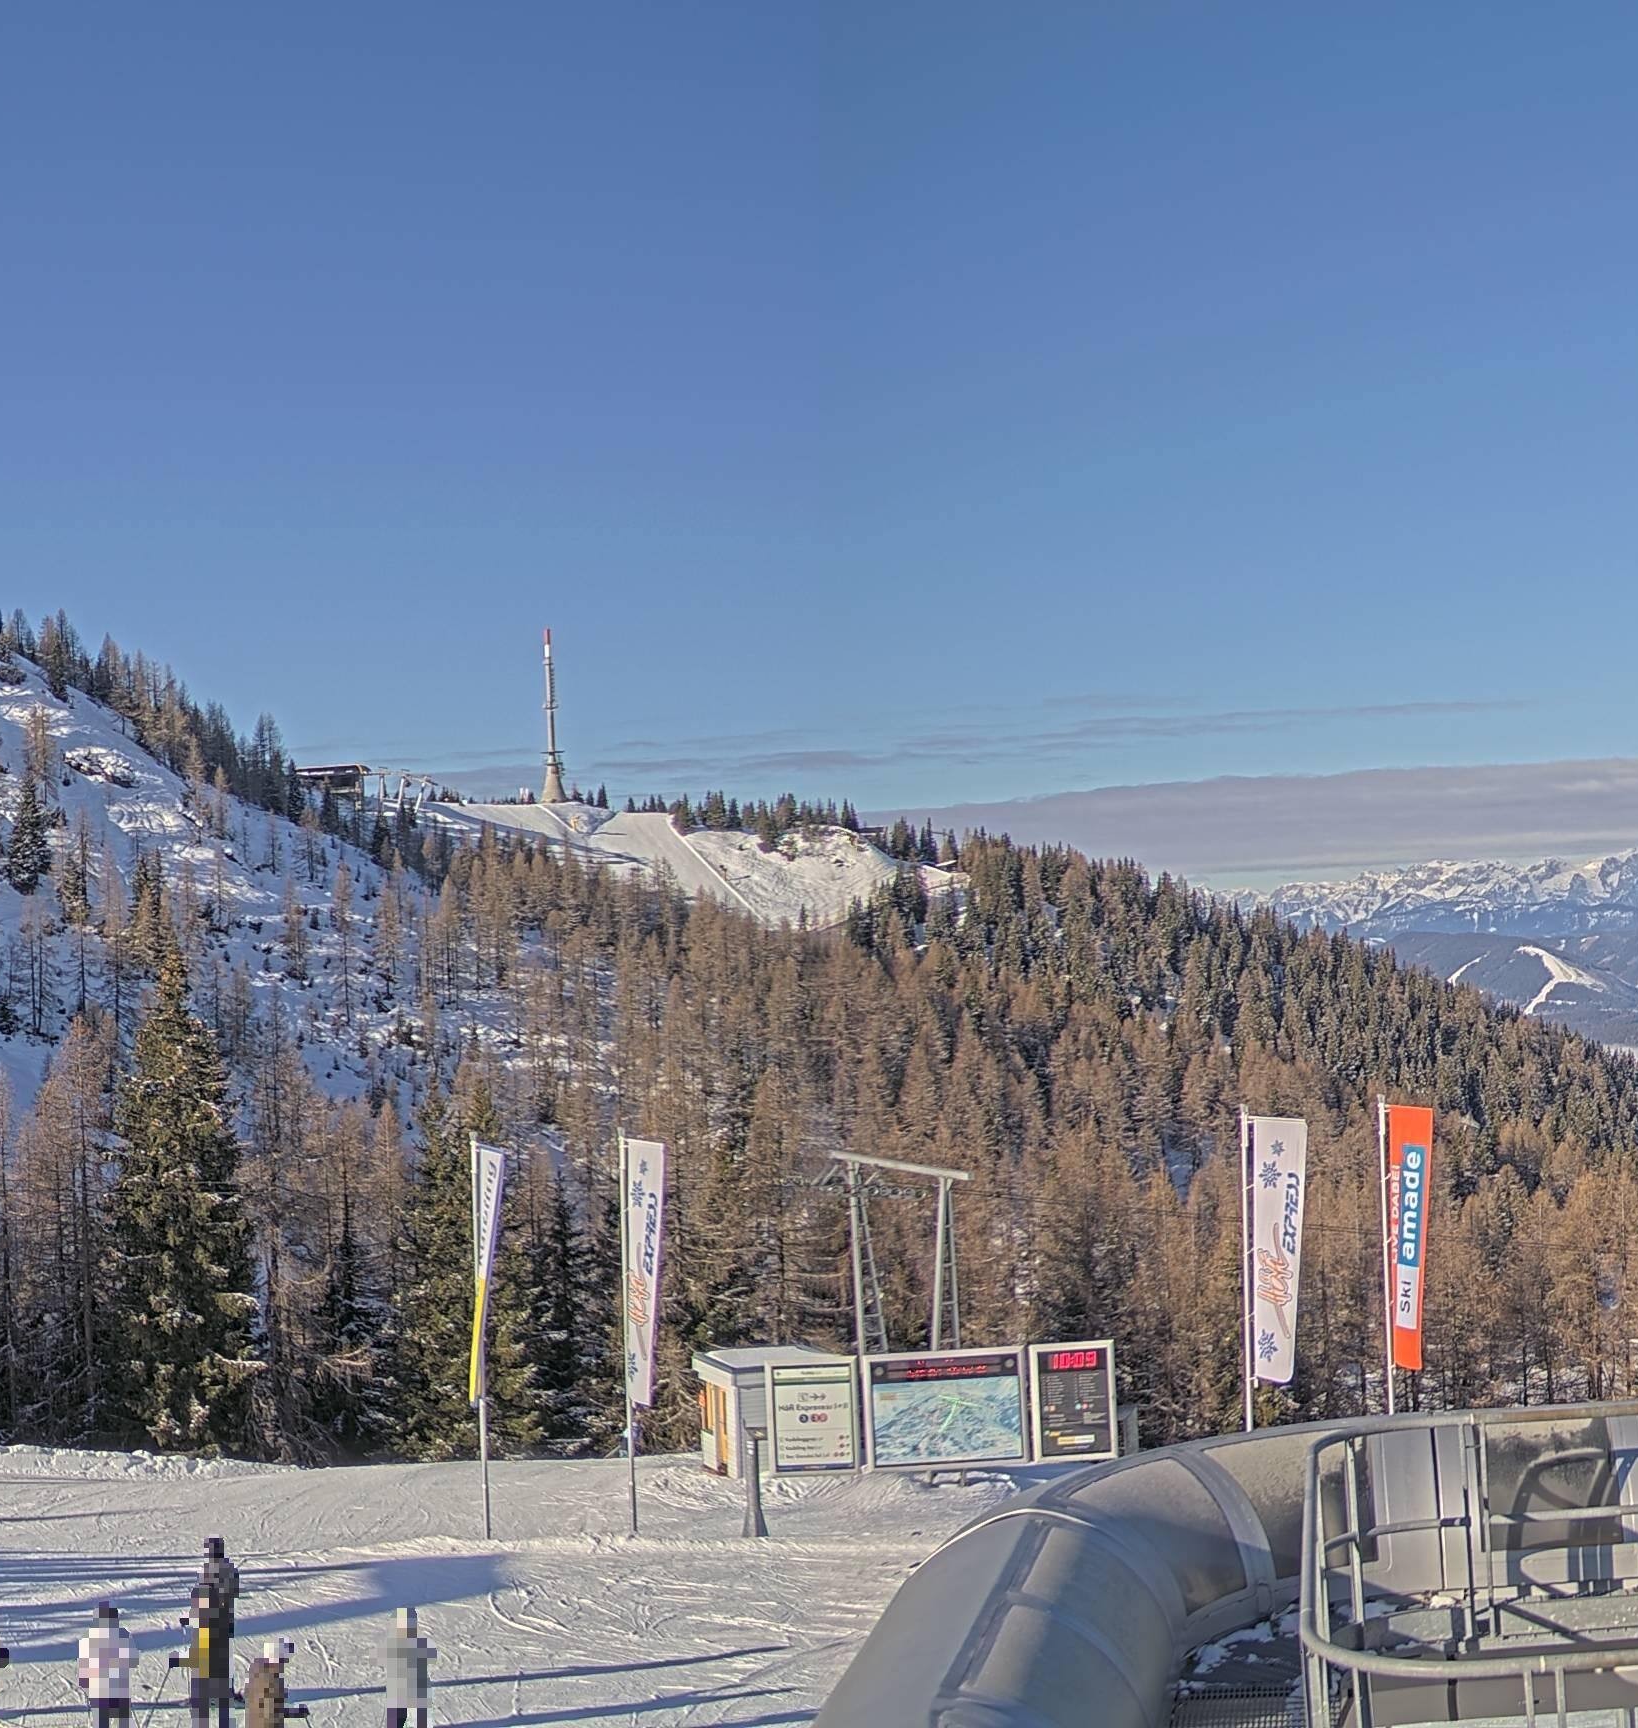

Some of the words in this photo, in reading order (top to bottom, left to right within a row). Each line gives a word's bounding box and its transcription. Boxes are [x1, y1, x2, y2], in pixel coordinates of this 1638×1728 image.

[1282, 1171, 1301, 1256] EXPRESS
[1400, 1280, 1412, 1313] Ski
[1051, 1350, 1097, 1370] 10:09
